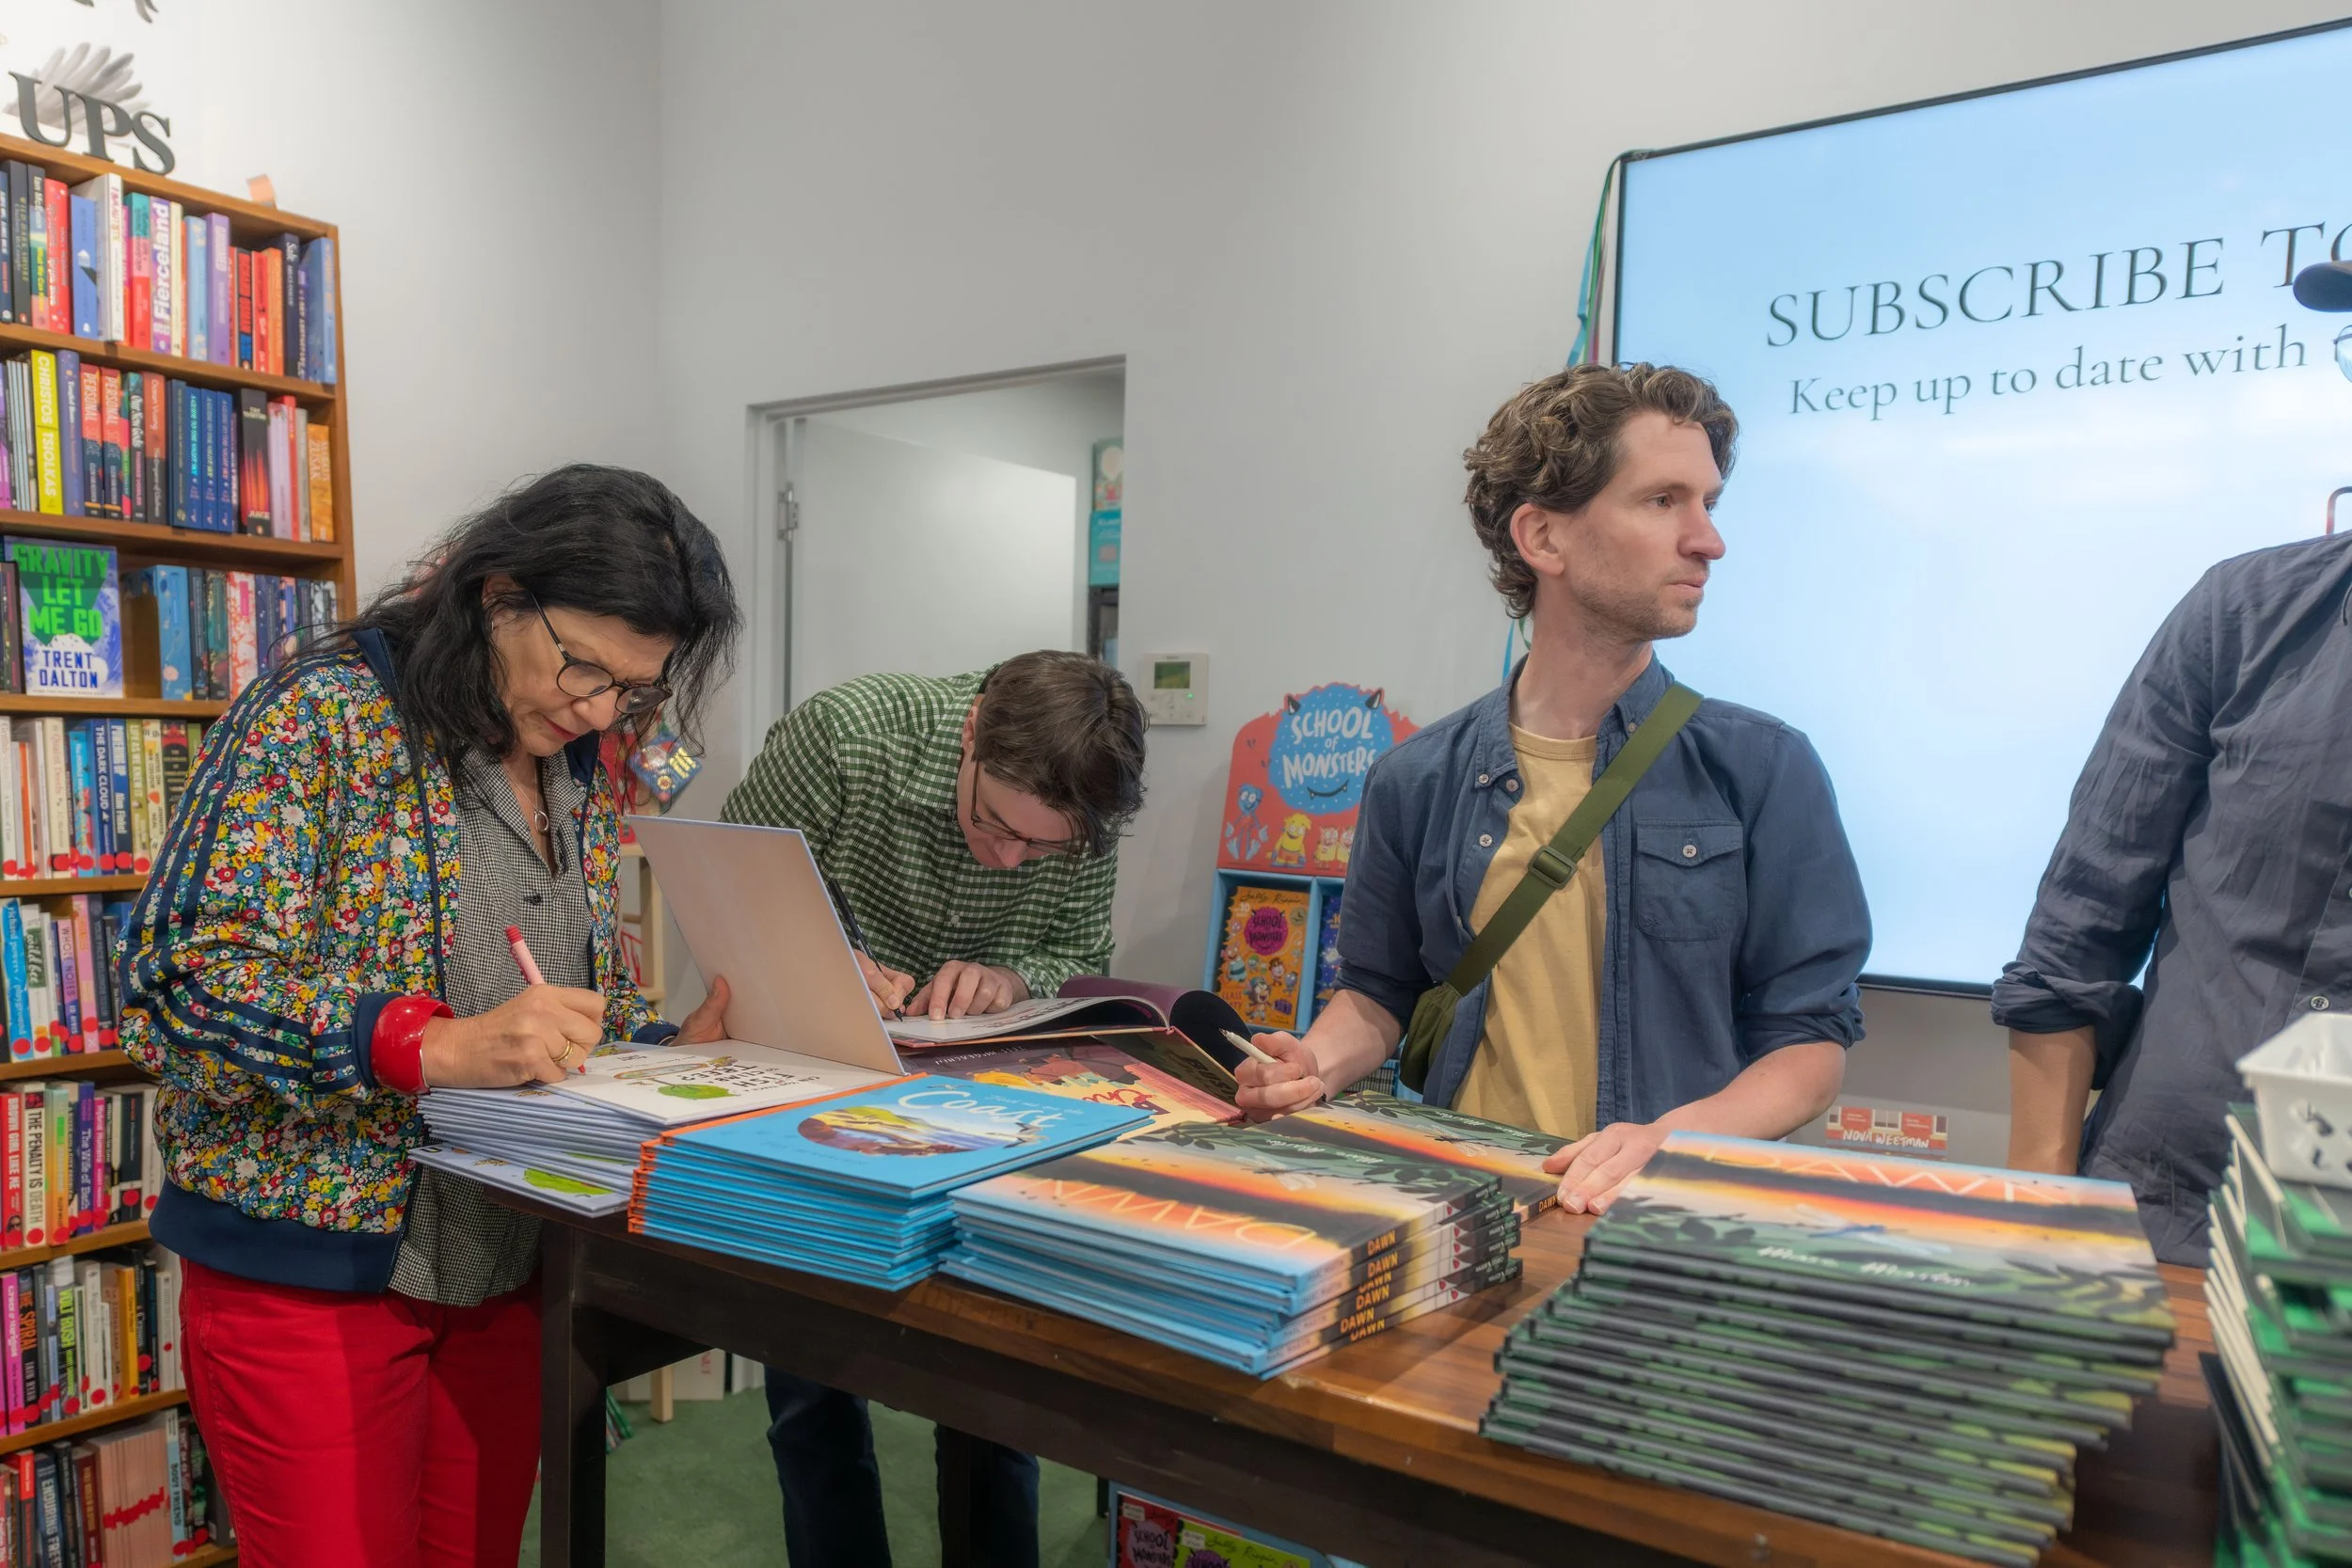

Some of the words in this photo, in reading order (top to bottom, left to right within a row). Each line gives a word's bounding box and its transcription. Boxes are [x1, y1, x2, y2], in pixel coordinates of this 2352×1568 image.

[8, 71, 176, 176] UPS
[33, 176, 42, 190] Ian
[34, 192, 43, 229] McEwan
[38, 265, 43, 275] We
[153, 202, 170, 319] Fierceland
[1767, 238, 2224, 347] SUBSCRIBE
[1790, 377, 1898, 421] Keep
[1915, 375, 1972, 415] up
[1992, 368, 2037, 396] to
[2056, 346, 2165, 390] date
[2183, 324, 2308, 377] with
[38, 356, 53, 424] CHRISTOS
[83, 372, 98, 421] PERSONAL
[105, 376, 119, 425] PERSONAL
[151, 405, 160, 431] Vuong
[42, 432, 56, 497] TSIOLKAS
[310, 439, 321, 481] ZUSAK
[12, 544, 109, 578] GRAVITY
[42, 576, 84, 606] LET
[28, 606, 65, 634] ME
[73, 610, 102, 638] GO
[42, 651, 92, 670] TRENT
[40, 670, 98, 689] DALTON
[96, 725, 104, 745] THE
[130, 724, 139, 741] LIFE
[1291, 706, 1374, 745] SCHOOL
[111, 725, 125, 765] POWERING
[132, 742, 140, 752] AS
[1325, 736, 1340, 751] of
[97, 747, 106, 773] DARK
[114, 765, 126, 776] UP
[132, 752, 141, 765] WE
[133, 766, 142, 788] KNEW
[99, 775, 108, 809] CLOUD
[115, 792, 125, 809] Alan
[134, 789, 143, 798] IT
[117, 810, 127, 833] Finkel
[8, 907, 20, 940] richard
[1252, 915, 1282, 927] SCHOOL
[61, 927, 72, 961] WHOLE
[11, 942, 21, 974] powers
[66, 966, 75, 996] NOTES
[11, 984, 26, 1035] playground
[731, 1072, 796, 1087] FISH
[8, 1098, 18, 1131] BROWN
[28, 1112, 41, 1130] THE
[898, 1090, 1067, 1128] Coast
[8, 1132, 19, 1153] GIRL
[82, 1129, 90, 1148] The
[1843, 1130, 1872, 1142] NOVA
[1875, 1133, 1930, 1148] WEETMAN
[9, 1155, 19, 1174] LIKE
[29, 1132, 42, 1174] PENALTY
[82, 1150, 90, 1171] Wife
[9, 1177, 20, 1189] ME
[30, 1179, 42, 1188] IS
[82, 1173, 90, 1183] of
[1703, 1147, 2081, 1204] DAWN
[29, 1191, 42, 1223] DEATH
[1024, 1176, 1319, 1252] DAWN
[1538, 1194, 1558, 1213] DAWN
[1367, 1231, 1396, 1256] DAWN
[1368, 1253, 1399, 1278] DAWN
[20, 1291, 33, 1307] THE
[59, 1288, 73, 1315] VOLT
[1356, 1285, 1390, 1311] DAWN
[20, 1310, 37, 1353] SPIRAL
[60, 1316, 75, 1348] RUSH
[1340, 1308, 1375, 1334] DAWN
[41, 1478, 58, 1535] ENDURING
[172, 1491, 183, 1527] FRIEND
